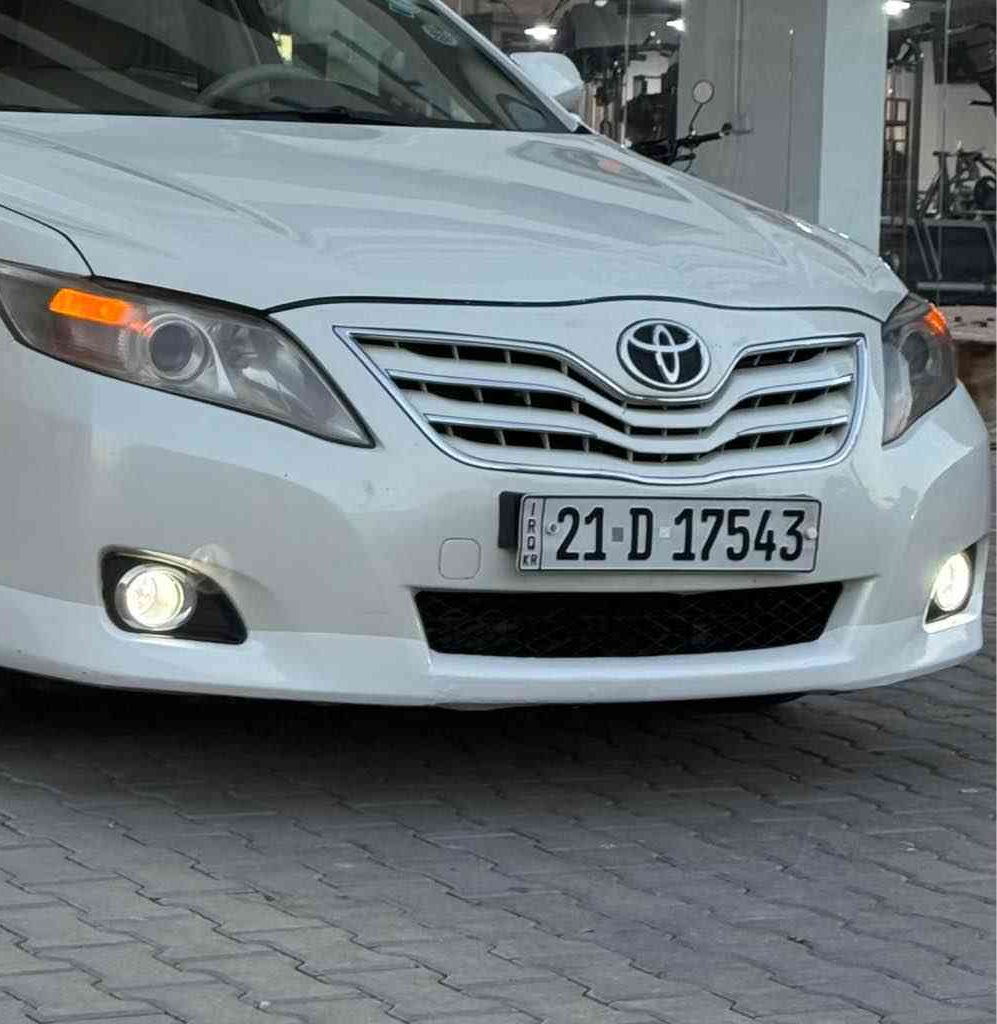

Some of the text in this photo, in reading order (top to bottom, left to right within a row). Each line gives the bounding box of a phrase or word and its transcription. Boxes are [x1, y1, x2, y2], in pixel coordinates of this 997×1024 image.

[555, 507, 806, 562] 21 D 17543
[523, 554, 538, 566] KR
